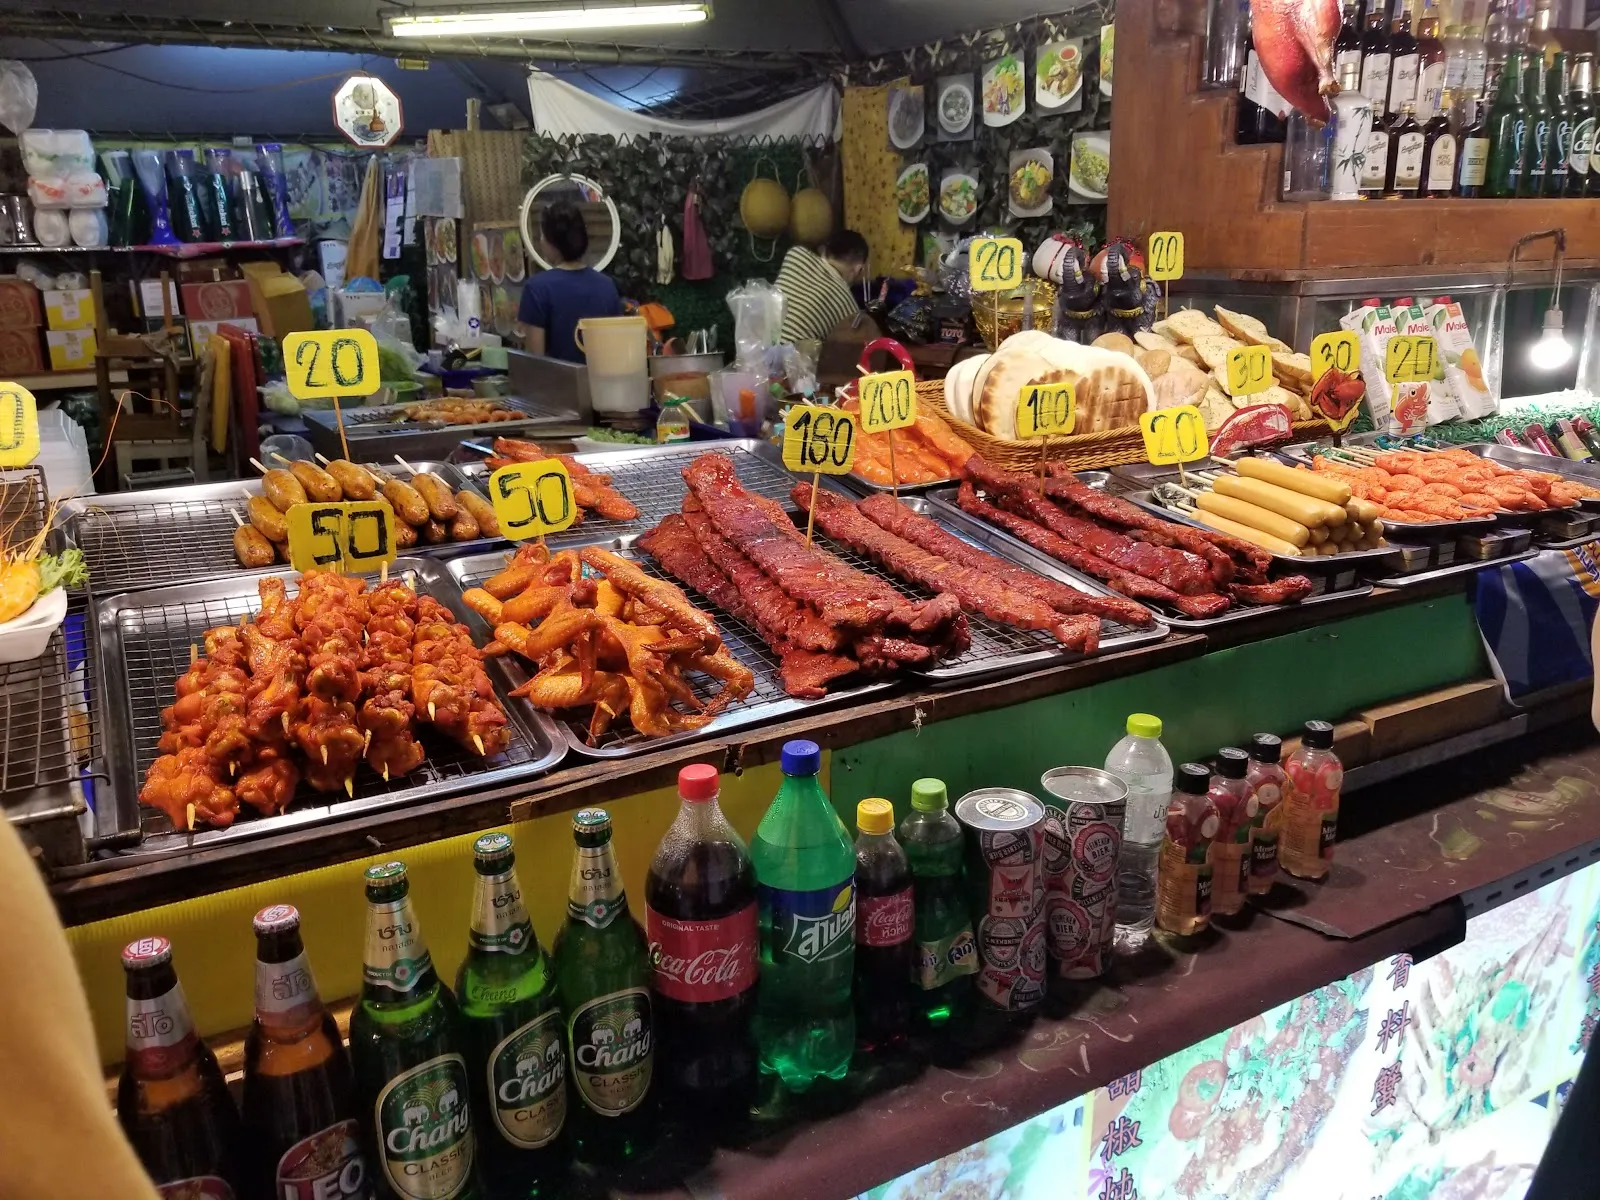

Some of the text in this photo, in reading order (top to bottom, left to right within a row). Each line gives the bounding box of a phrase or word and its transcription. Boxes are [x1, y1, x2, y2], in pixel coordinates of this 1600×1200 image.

[975, 241, 1015, 282] 20
[1152, 236, 1178, 272] 20
[296, 338, 364, 388] 20
[1233, 351, 1266, 389] 30
[1320, 340, 1352, 372] 30
[1393, 339, 1433, 378] 20
[863, 378, 911, 426] 200
[1027, 388, 1069, 432] 100
[1150, 411, 1199, 457] 20
[497, 471, 570, 528] 50
[311, 508, 389, 565] 50
[1085, 837, 1110, 852] HEINEKEN
[263, 905, 290, 922] LEO
[662, 920, 720, 932] ORIGINAL TASTE
[138, 937, 154, 955] LEO
[577, 1030, 650, 1068] Chang
[387, 1102, 469, 1153] Chang
